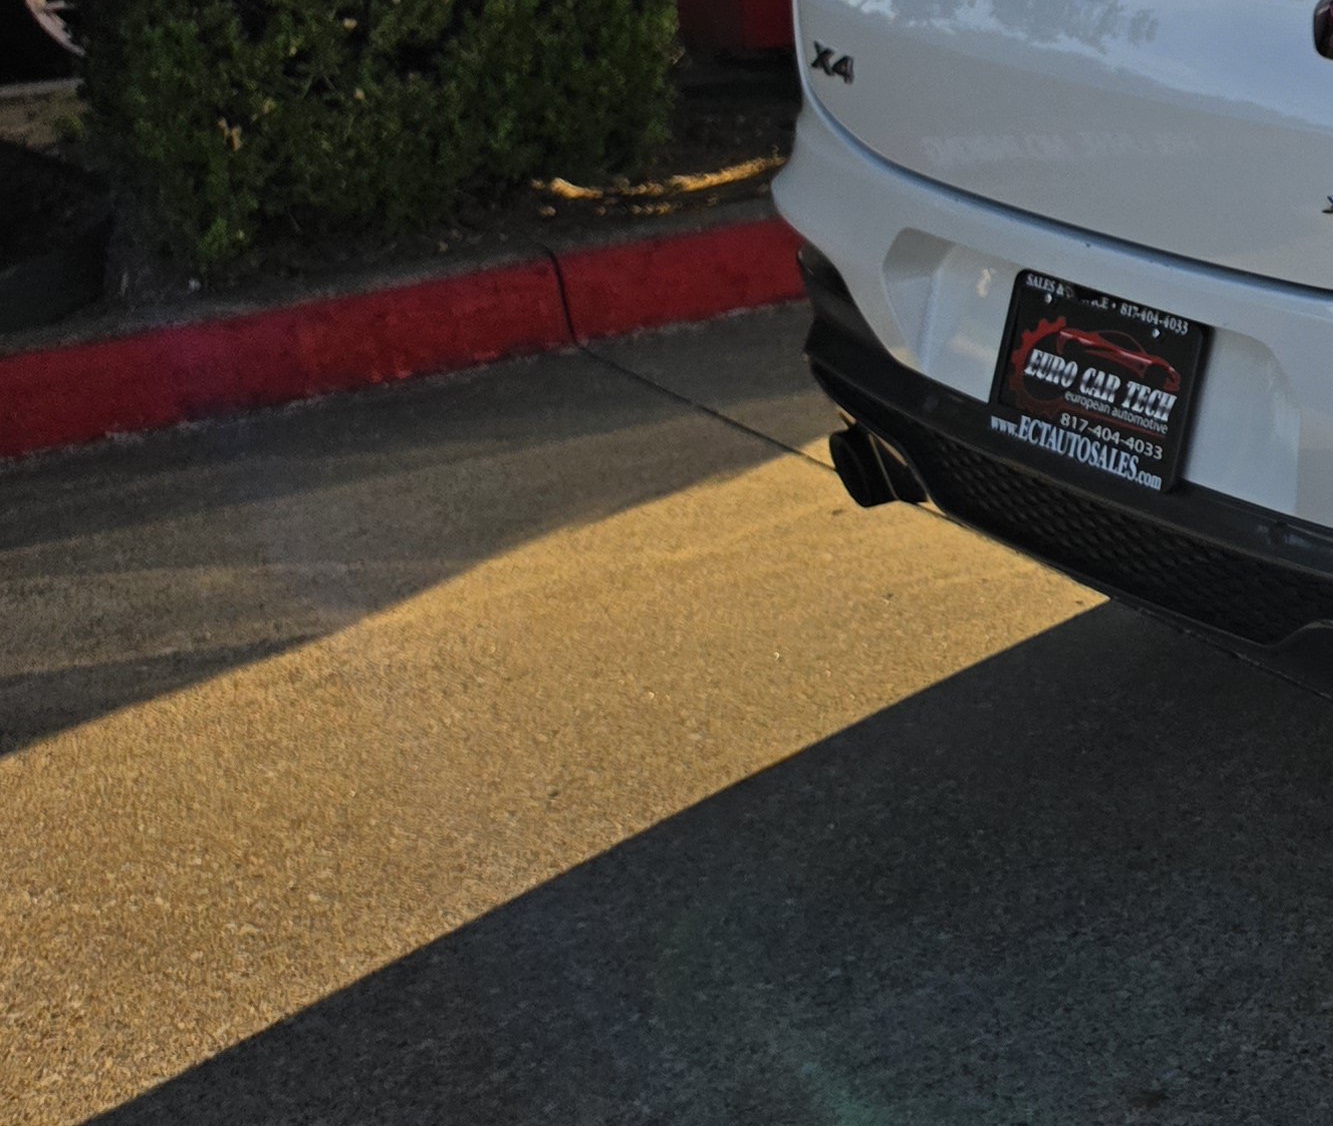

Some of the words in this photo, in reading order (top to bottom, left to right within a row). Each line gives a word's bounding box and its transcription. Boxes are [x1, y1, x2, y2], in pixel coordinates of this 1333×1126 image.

[811, 40, 855, 84] X4
[1026, 273, 1056, 295] SALES
[1120, 301, 1189, 335] 817-404-4033
[1024, 349, 1078, 388] EURO
[1079, 369, 1121, 406] CAR
[1121, 380, 1178, 422] TECH
[1065, 390, 1111, 414] european
[1111, 404, 1168, 434] automotive
[990, 415, 1162, 491] www.ECTAUTOSALES.com
[1060, 413, 1163, 460] 817-404-4033
